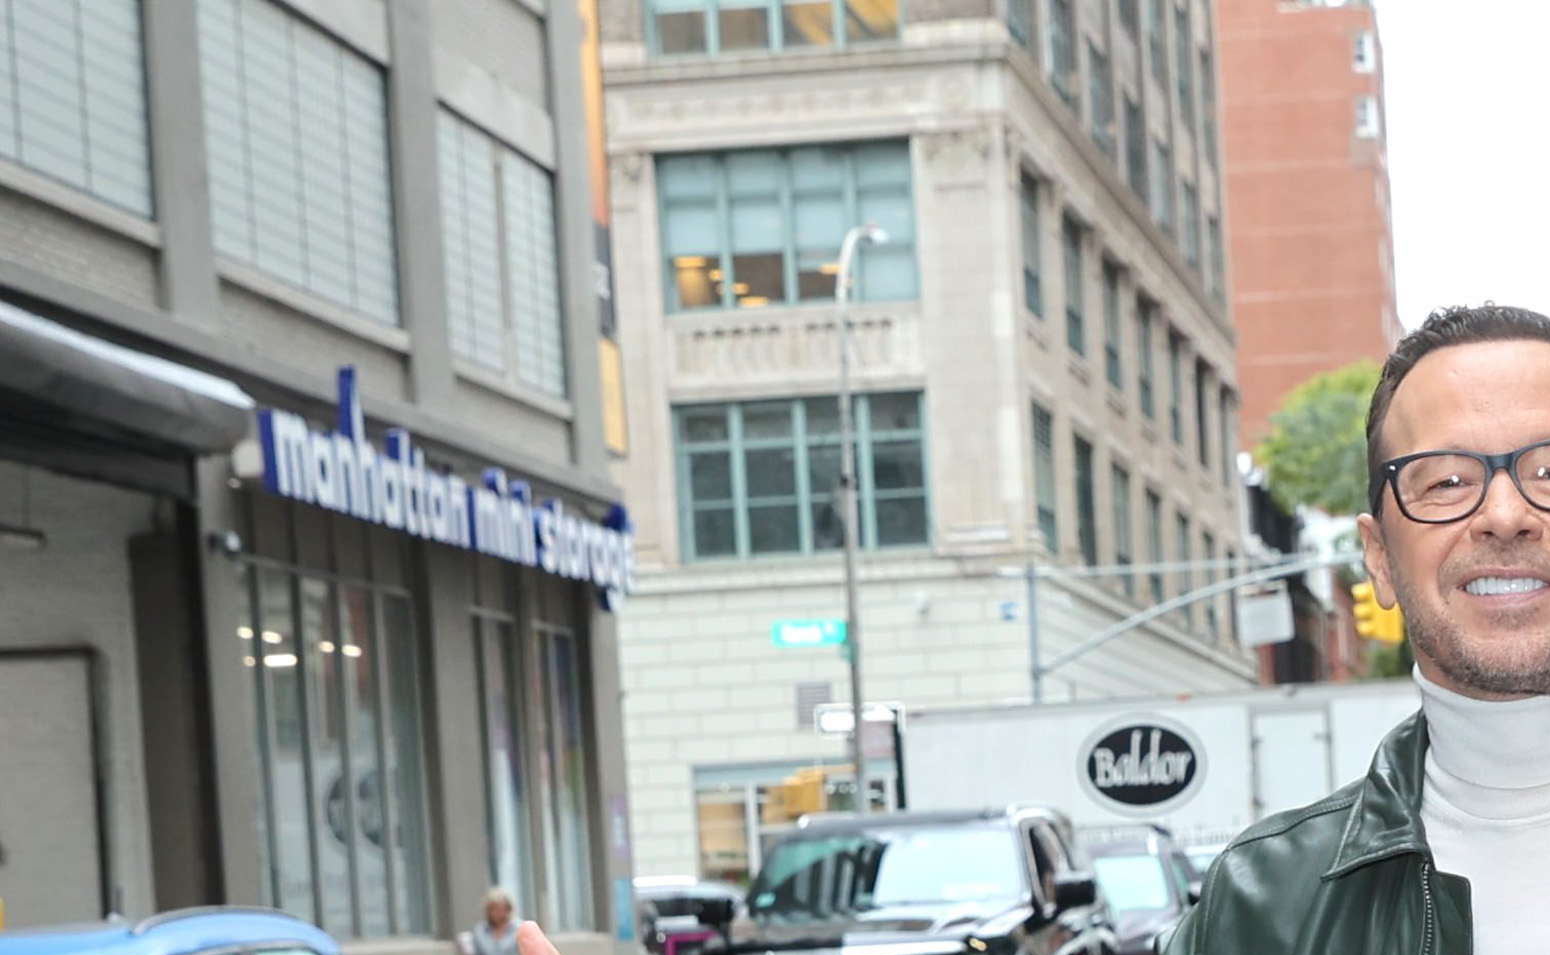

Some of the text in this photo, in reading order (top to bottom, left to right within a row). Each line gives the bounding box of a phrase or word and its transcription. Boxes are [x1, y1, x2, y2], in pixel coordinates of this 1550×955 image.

[260, 365, 472, 549] manhattan
[468, 467, 536, 567] mini
[1094, 728, 1193, 788] Baldor
